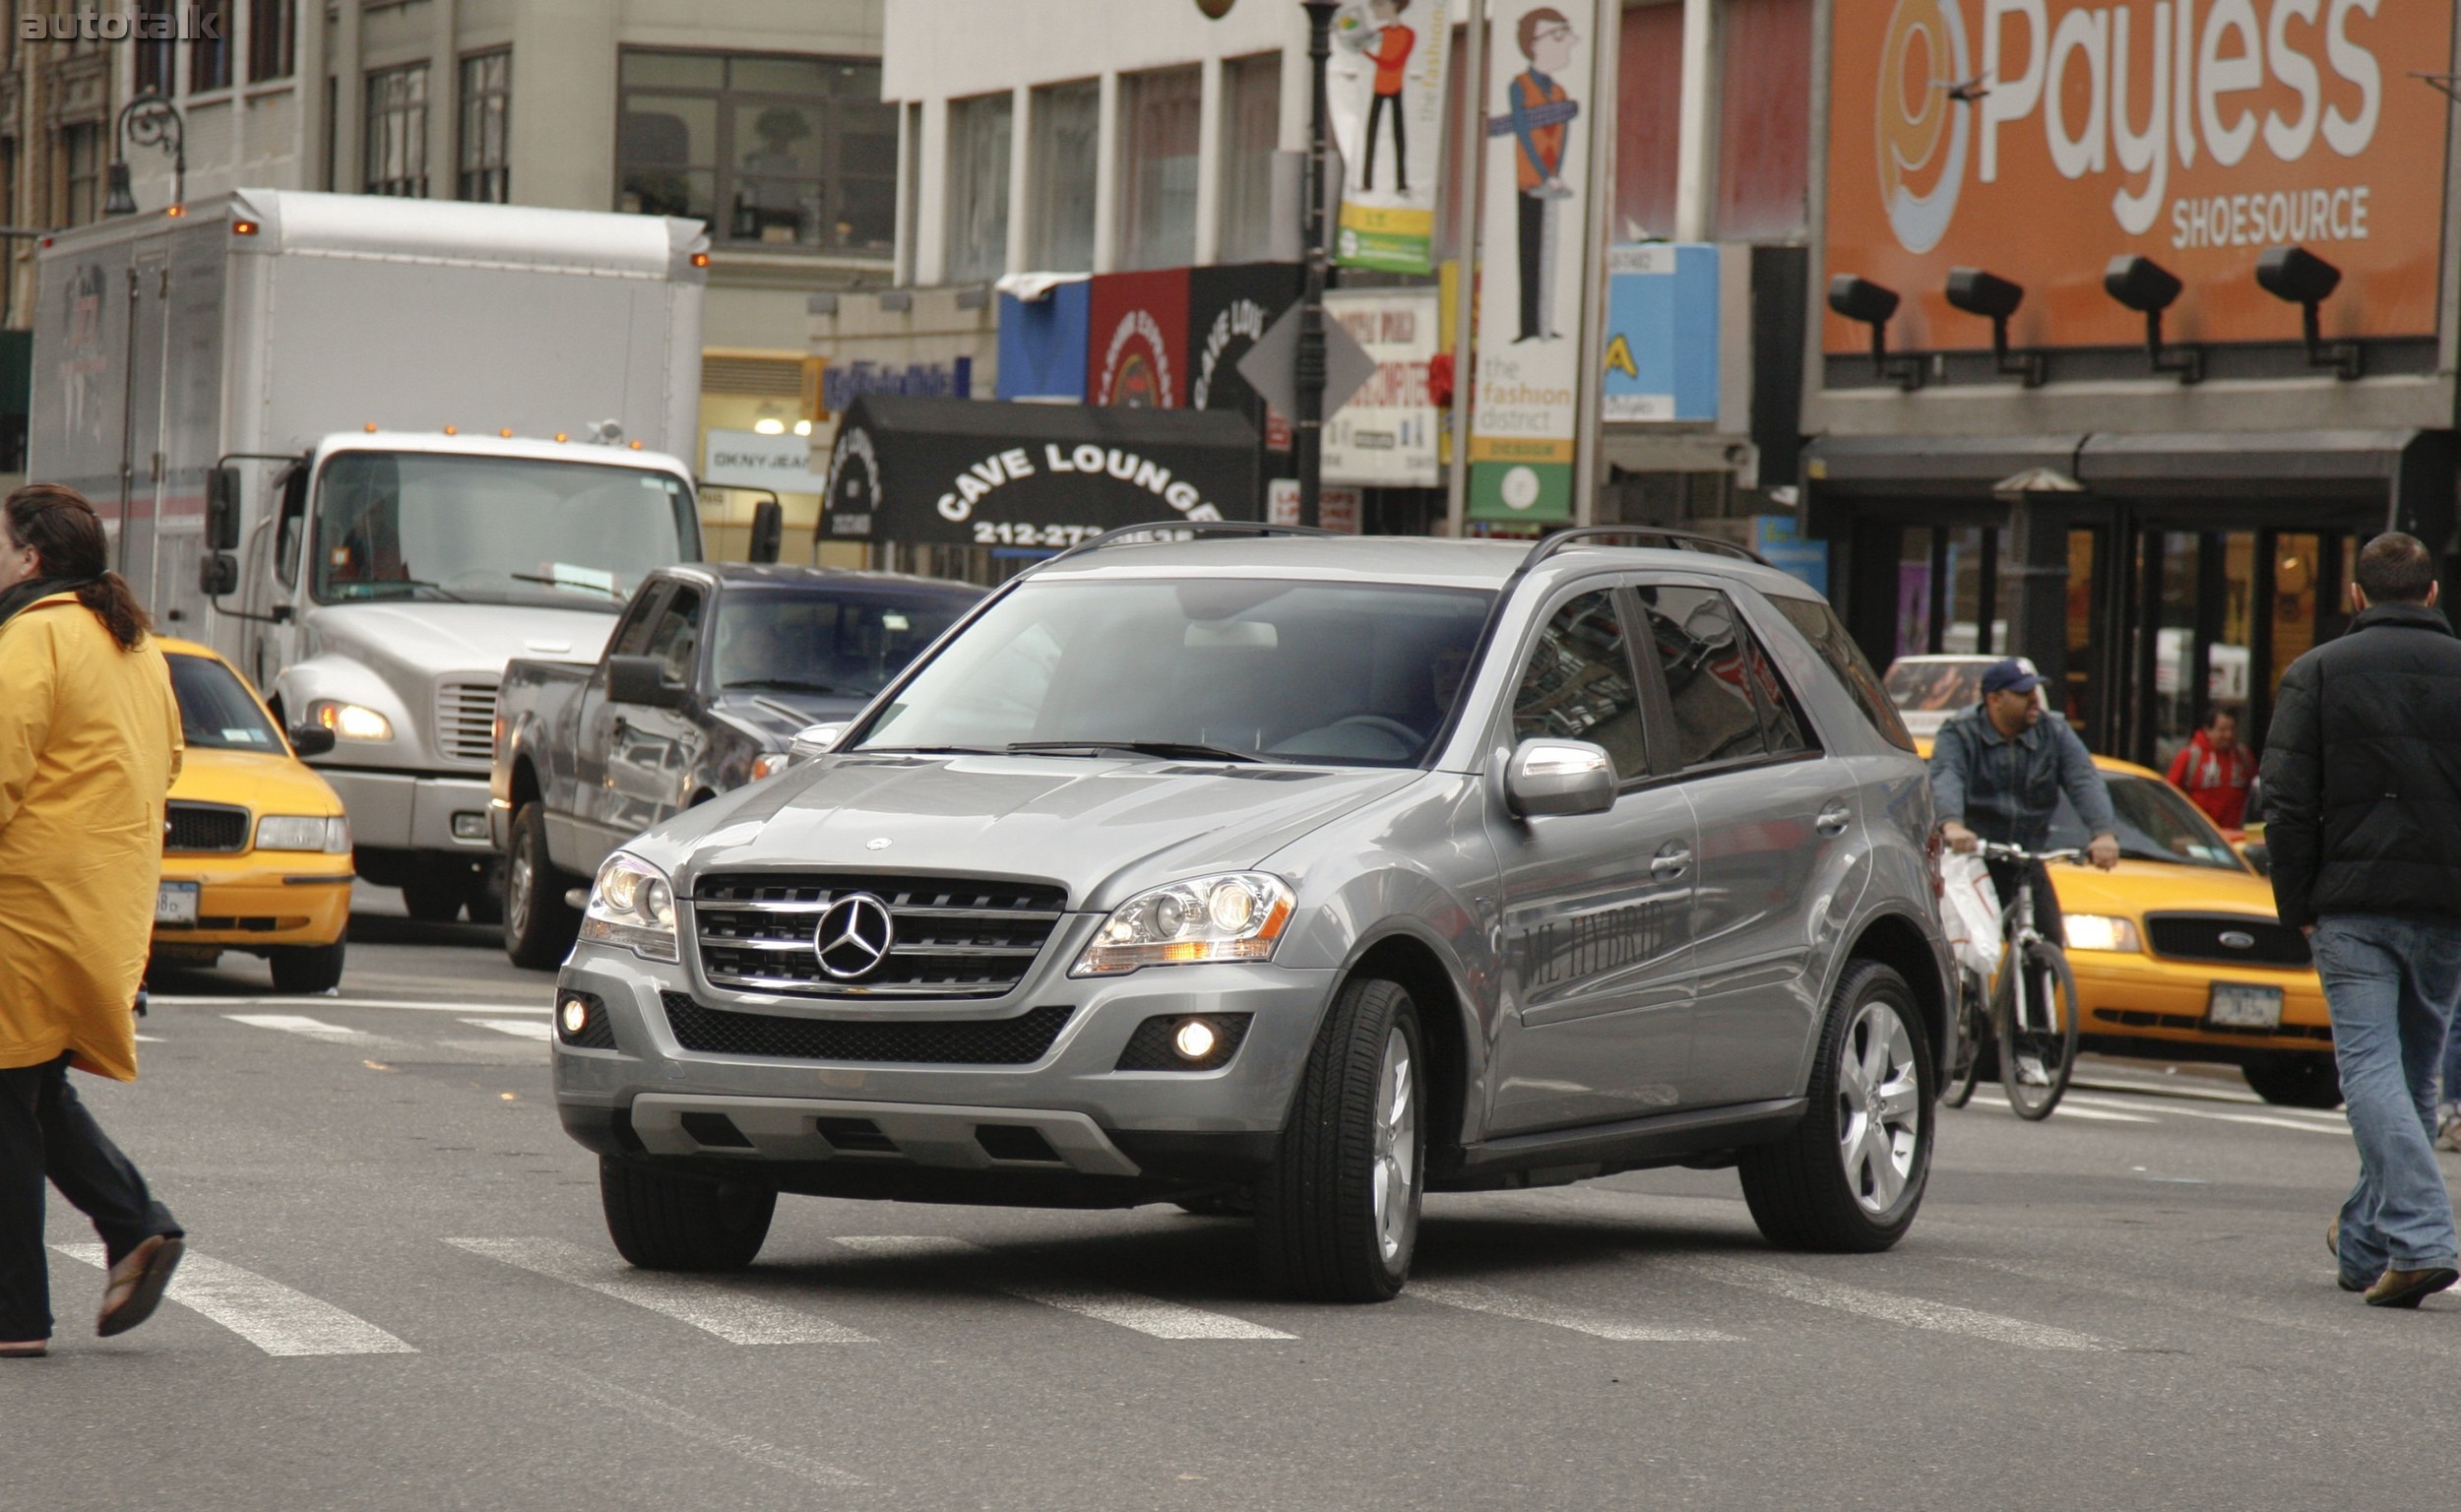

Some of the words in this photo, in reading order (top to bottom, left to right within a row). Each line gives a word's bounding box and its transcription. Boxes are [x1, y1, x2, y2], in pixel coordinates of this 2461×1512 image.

[1979, 0, 2382, 236] Payless
[2172, 185, 2369, 250] SHOESOURCE
[1484, 355, 1519, 379] the
[1483, 381, 1572, 407] fashion
[1480, 407, 1551, 431] district
[713, 452, 766, 468] DKNY
[937, 447, 1036, 523] CAVE
[1044, 443, 1225, 524] LOUNGE
[1568, 900, 1664, 977] HYBRID
